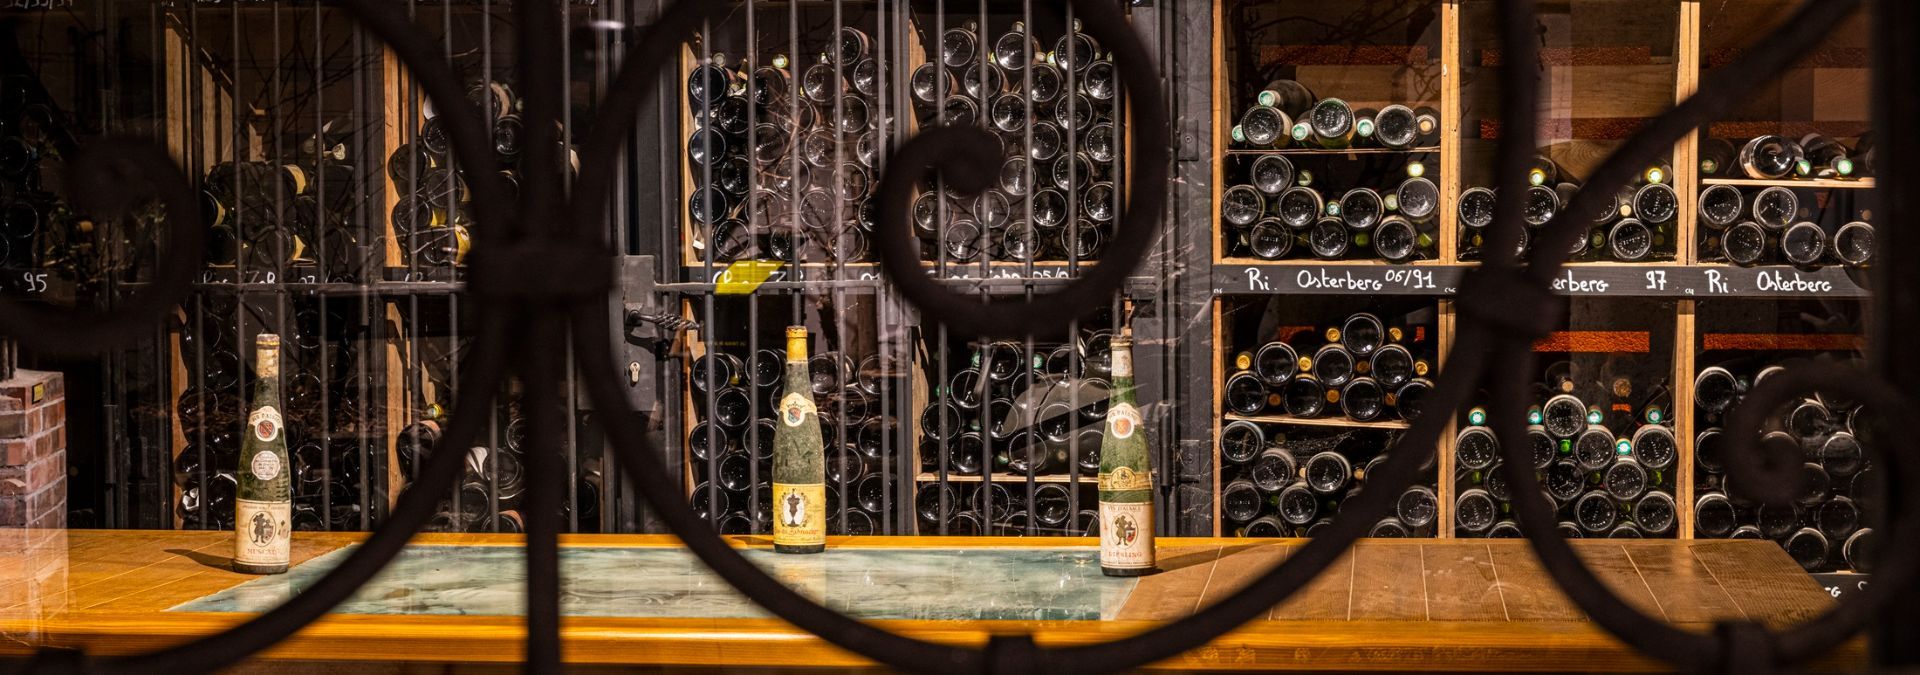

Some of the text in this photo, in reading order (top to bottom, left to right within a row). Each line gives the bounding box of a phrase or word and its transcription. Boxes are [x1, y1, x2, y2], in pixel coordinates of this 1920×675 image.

[23, 271, 48, 293] 95
[1296, 268, 1384, 291] Osterberg
[1385, 268, 1437, 289] 06/91
[1756, 270, 1832, 291] Osterberg
